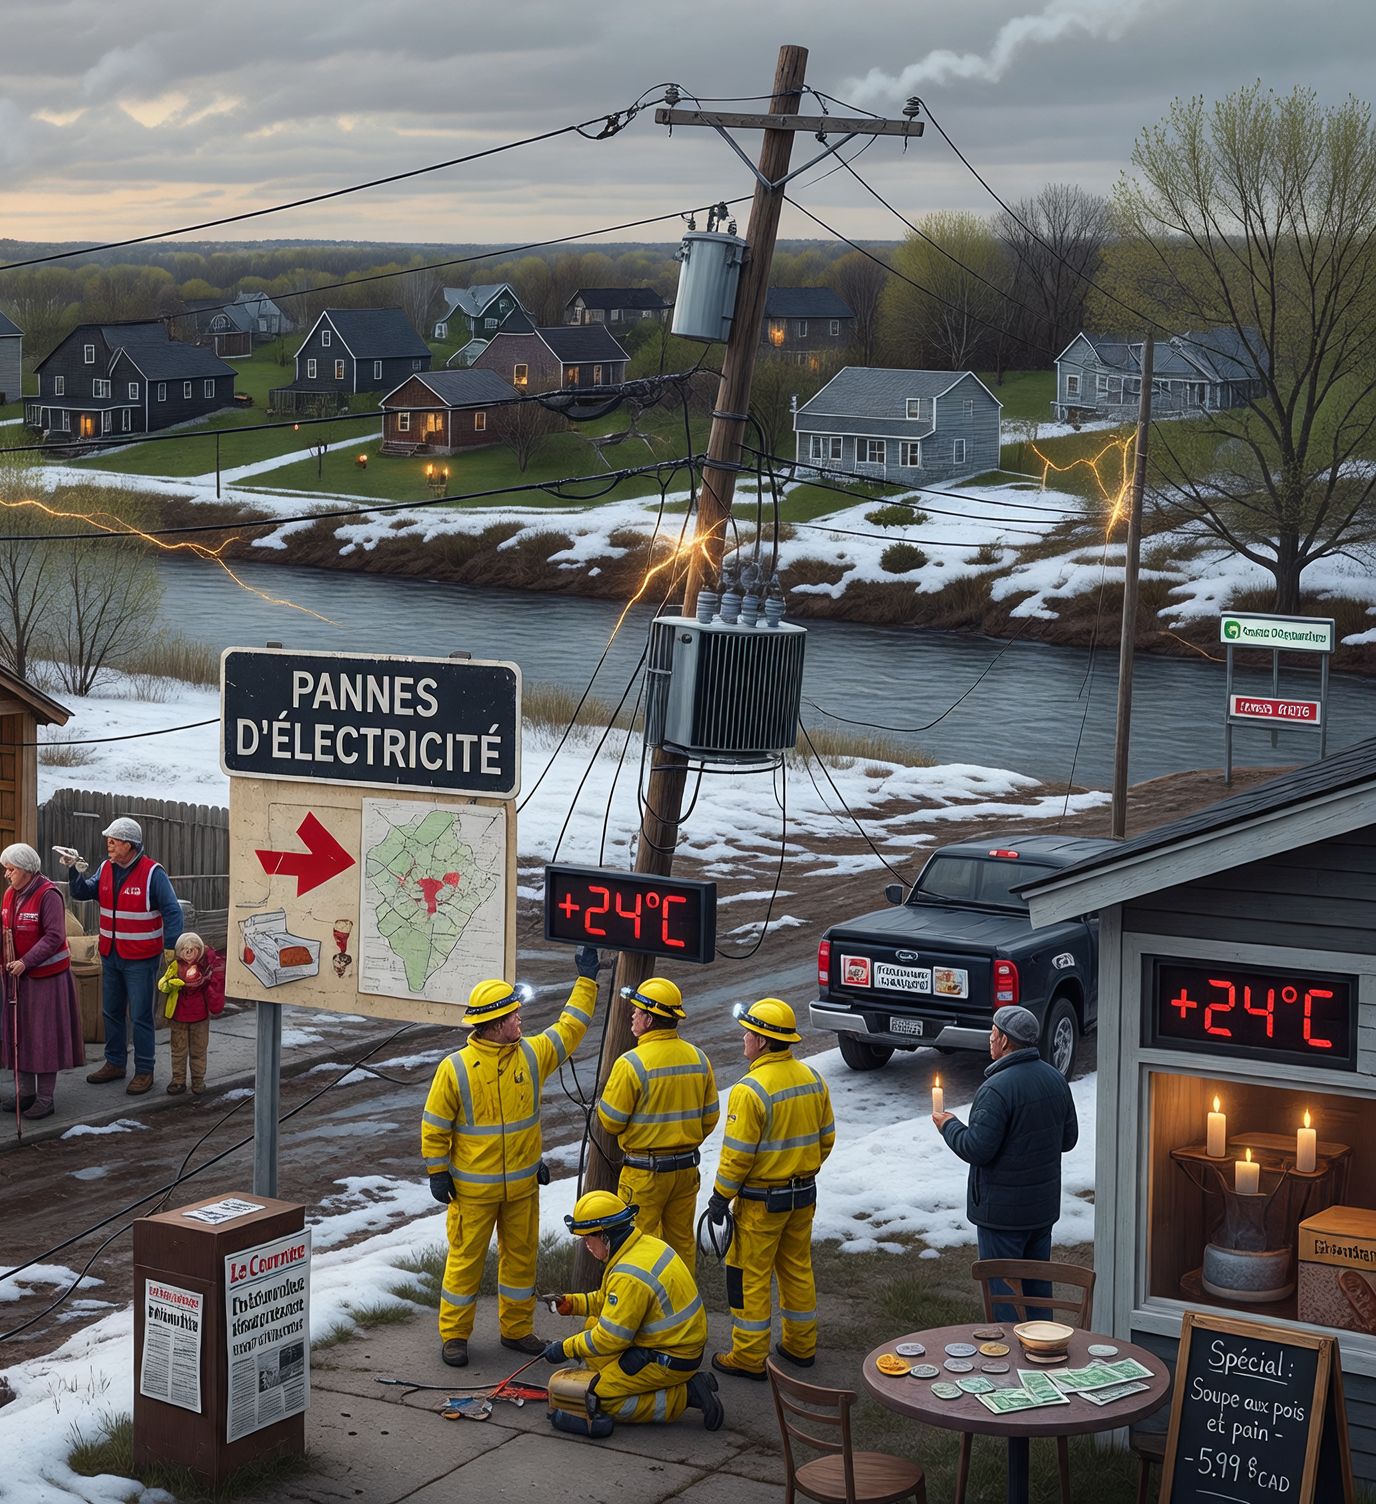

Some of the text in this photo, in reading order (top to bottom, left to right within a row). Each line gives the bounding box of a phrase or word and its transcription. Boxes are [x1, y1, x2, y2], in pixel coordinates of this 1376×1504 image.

[292, 670, 439, 718] PANNES
[236, 710, 502, 775] D'ÉLECTRICITÉ
[558, 885, 687, 948] +24°C
[1170, 979, 1334, 1048] +24°C
[1190, 1377, 1305, 1425] Soupe aux pois
[1207, 1413, 1225, 1434] et
[1232, 1421, 1269, 1445] pain
